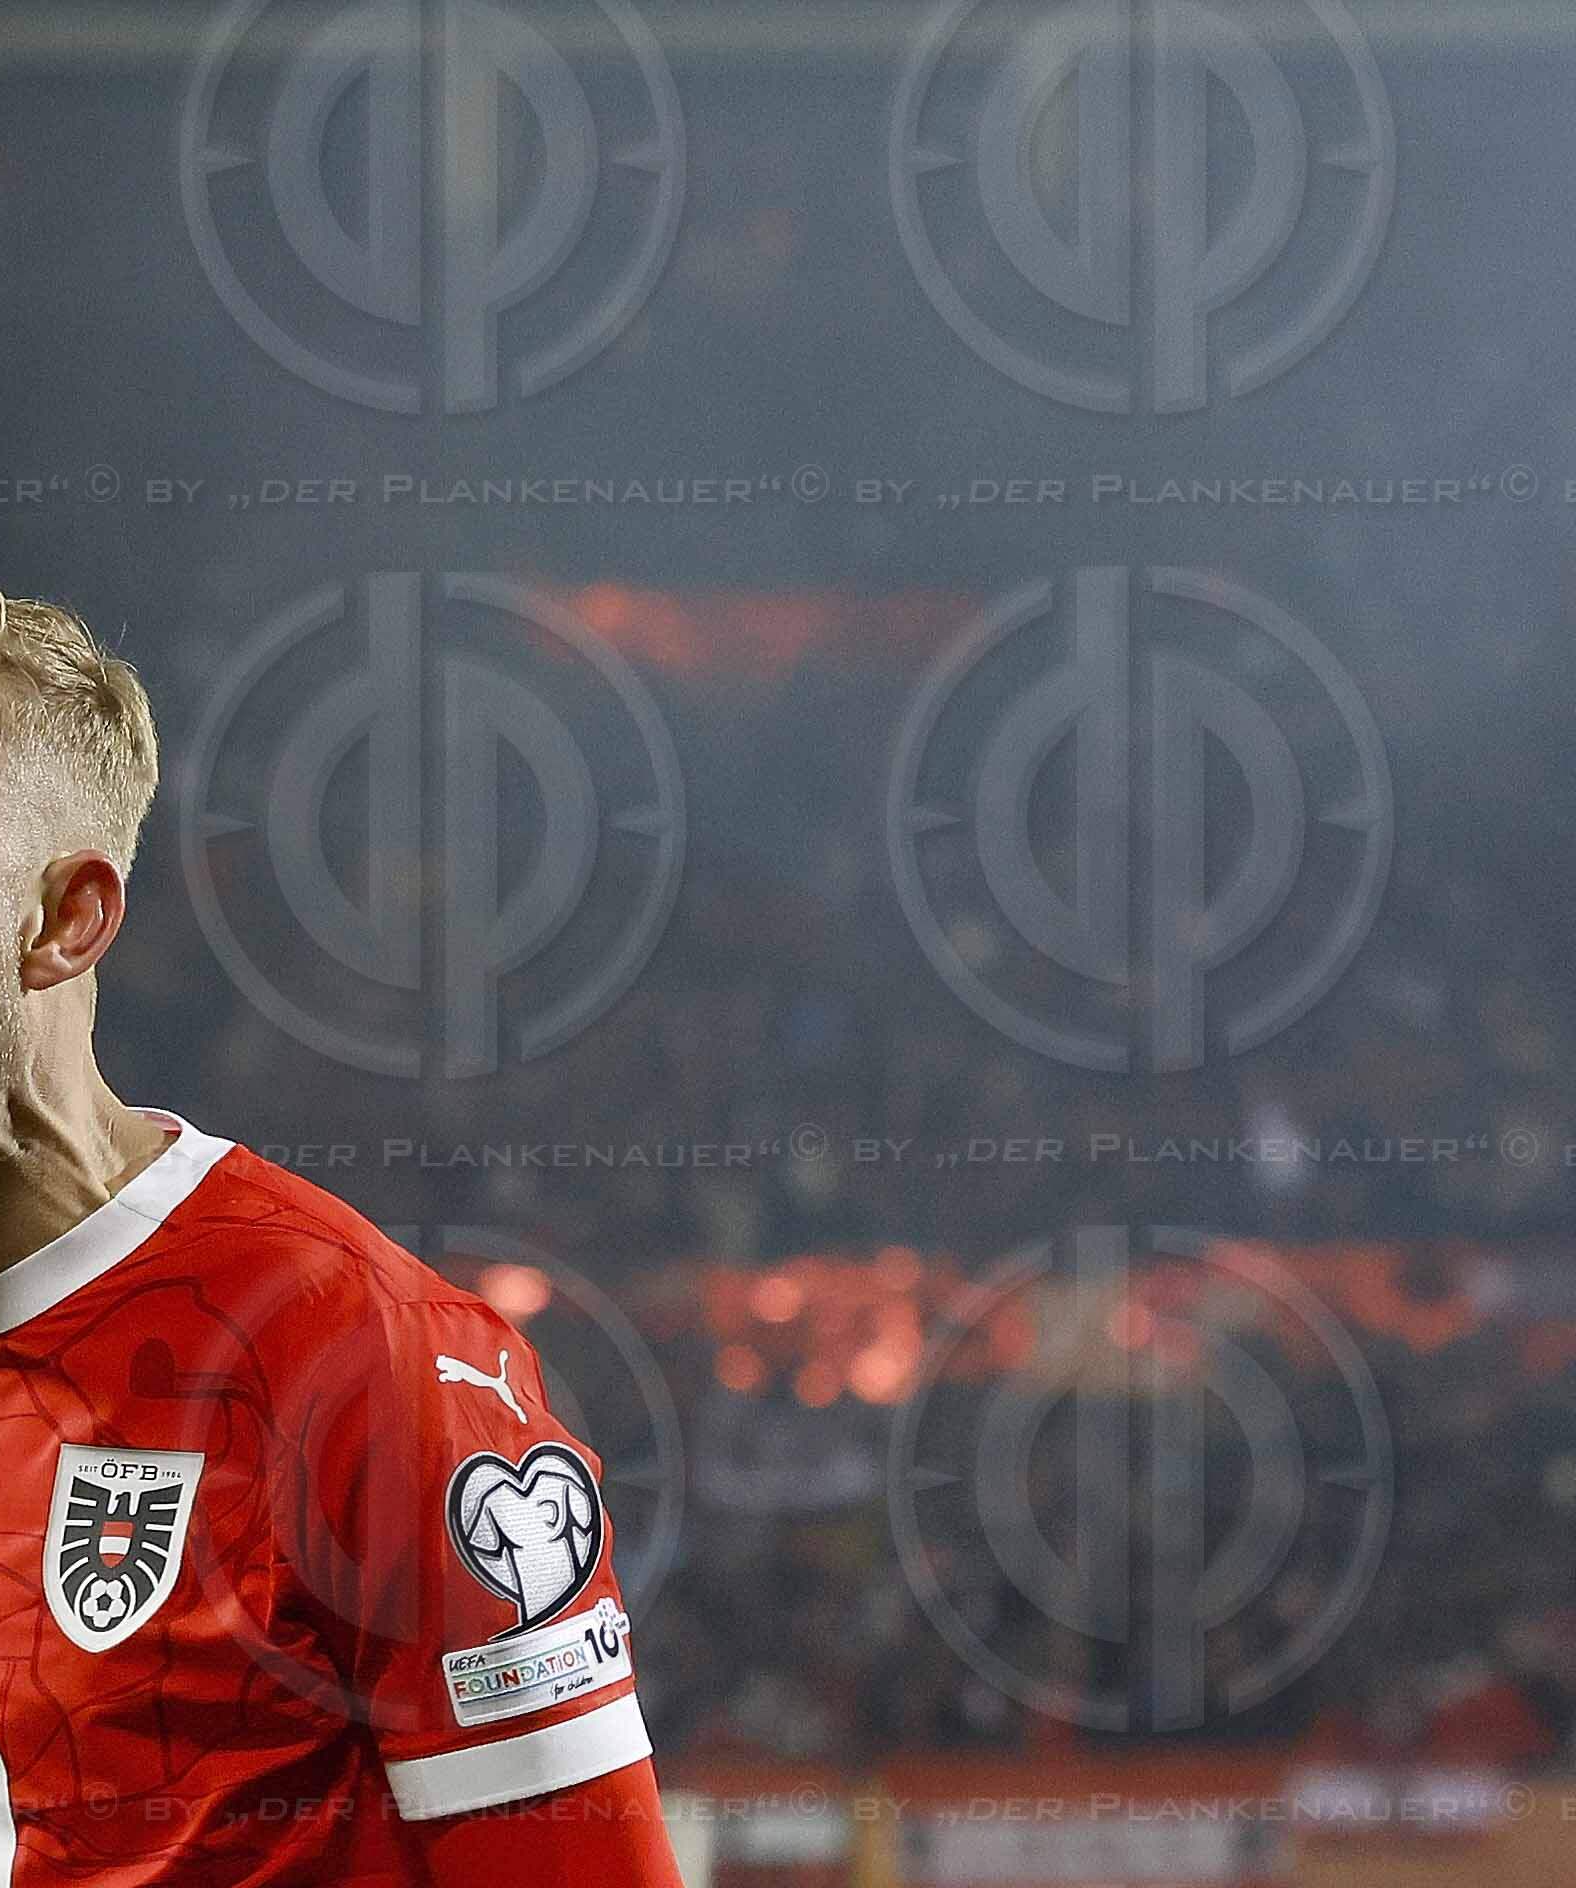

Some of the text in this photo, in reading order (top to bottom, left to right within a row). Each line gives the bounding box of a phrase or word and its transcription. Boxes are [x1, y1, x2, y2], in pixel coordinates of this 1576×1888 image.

[101, 1458, 158, 1481] ÖFB
[449, 1653, 486, 1672] UEFA
[453, 1646, 586, 1698] FOUNDATION
